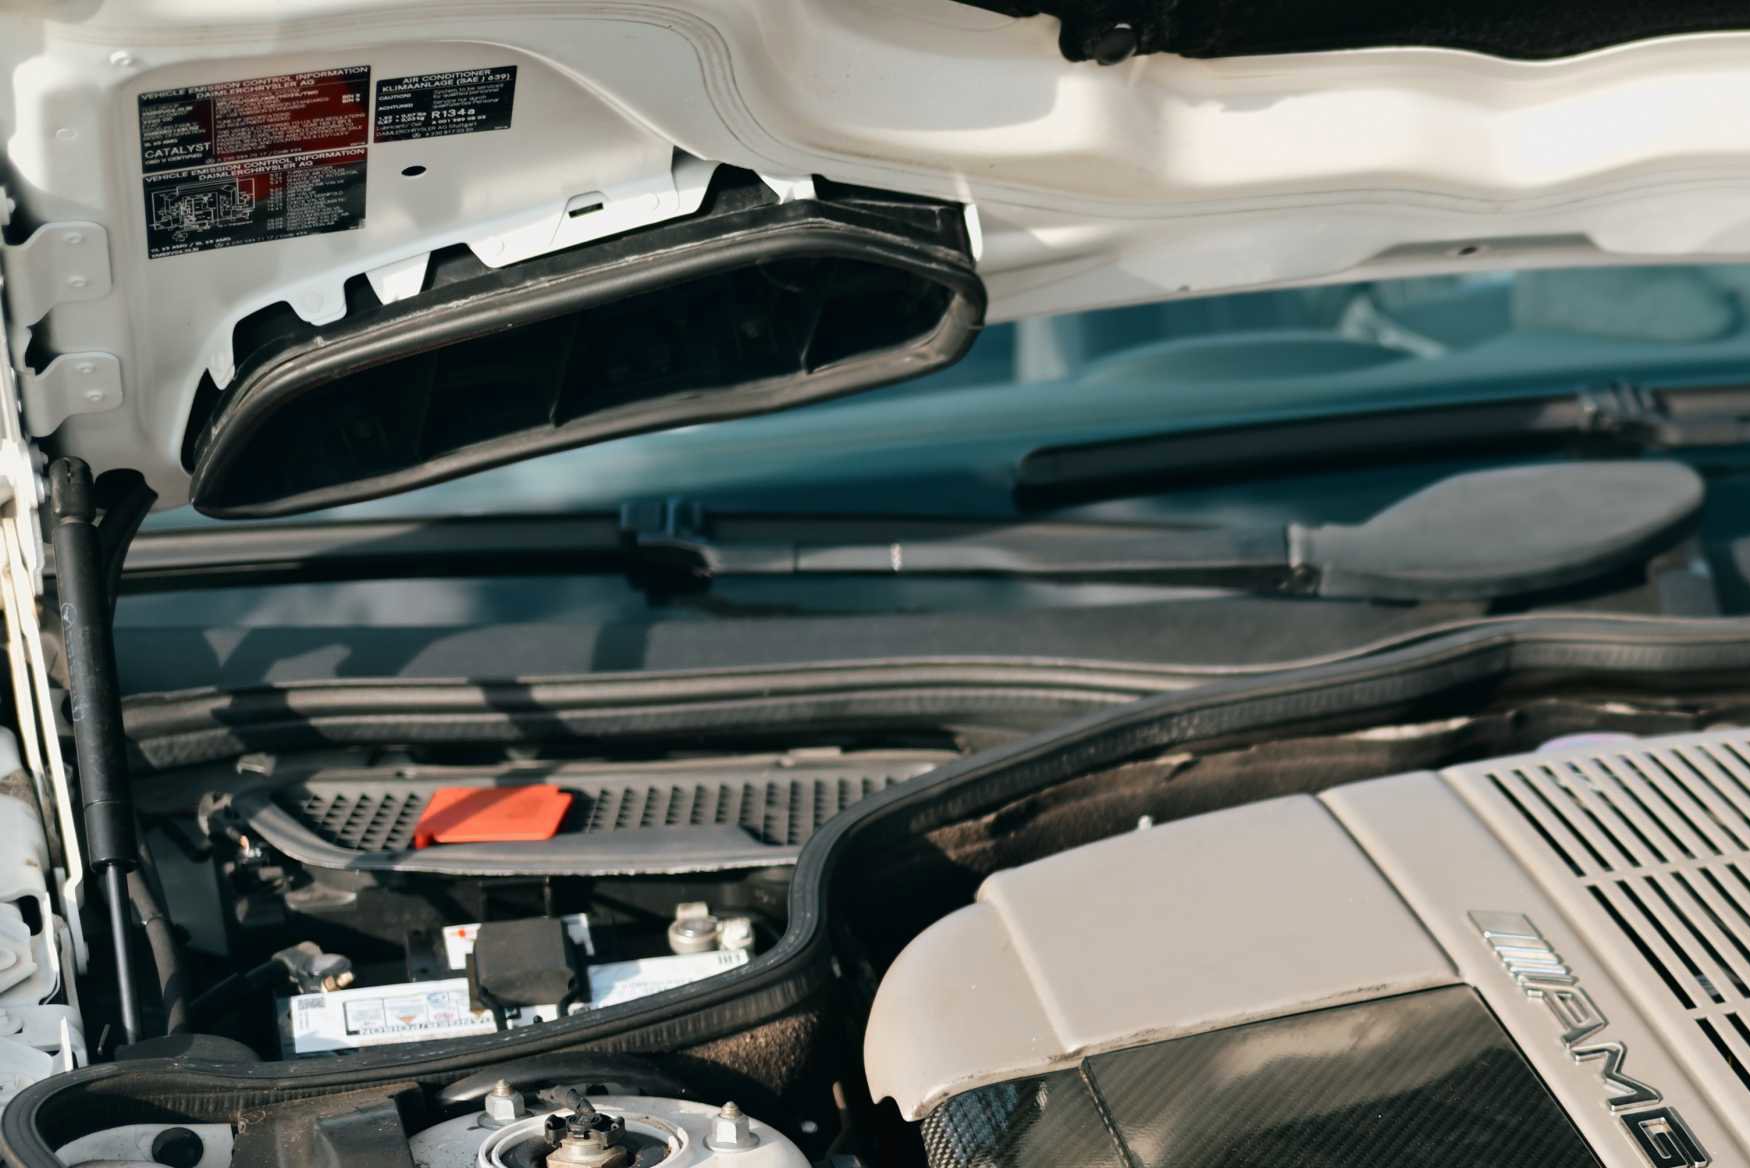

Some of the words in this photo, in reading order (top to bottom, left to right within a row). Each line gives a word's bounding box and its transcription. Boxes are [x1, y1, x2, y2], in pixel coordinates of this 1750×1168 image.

[143, 88, 185, 100] VEHICLE
[188, 82, 240, 93] EMISSION
[243, 76, 290, 87] CONTROL
[296, 67, 368, 80] INFORMATION
[422, 70, 491, 81] CONDITIONER
[196, 82, 297, 99] DAIMLERCHRYSLER
[382, 80, 453, 92] KLIMAANLAGE
[431, 108, 475, 119] R134a
[145, 142, 211, 158] CATALYST
[145, 170, 188, 183] VEHICLE
[191, 164, 242, 176] EMISSION
[244, 158, 291, 170] CONTROL
[295, 148, 365, 162] INFORMATION
[199, 163, 297, 180] DAIMLERCHRYSLER
